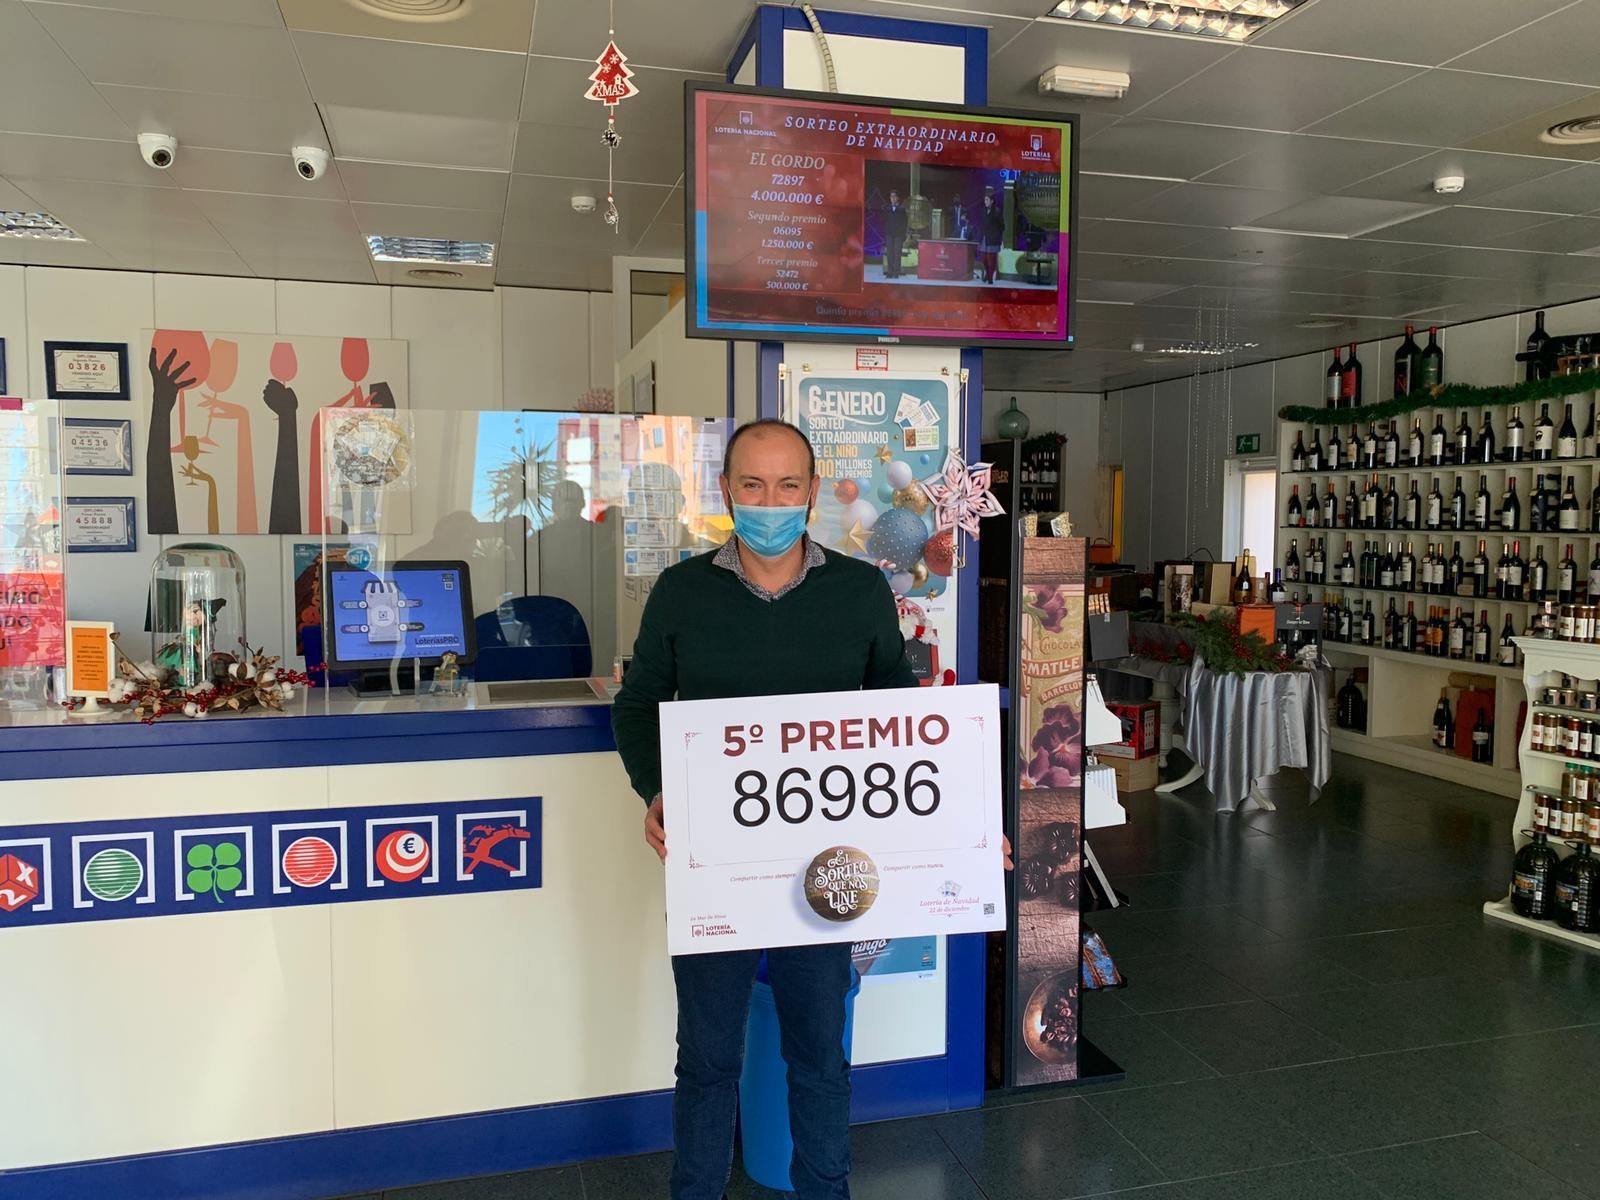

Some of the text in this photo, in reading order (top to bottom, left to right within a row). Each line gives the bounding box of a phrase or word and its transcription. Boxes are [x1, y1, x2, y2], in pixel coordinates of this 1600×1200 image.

[595, 82, 625, 97] XMAS
[743, 128, 777, 137] NACIONAL
[784, 116, 996, 144] SORTEO EXTRAORDINARIO
[846, 134, 944, 153] DE NAVIDAD
[749, 152, 825, 170] EL GORDO
[771, 174, 805, 186] 72897
[751, 190, 824, 205] 4.000.000 €
[747, 210, 827, 225] Segundo premio
[773, 226, 802, 236] 06095
[806, 241, 815, 250] €
[756, 255, 818, 268] Tercer premio
[766, 280, 801, 290] 500.000
[68, 362, 106, 371] 03826
[809, 385, 821, 413] 6
[825, 391, 886, 416] ENERO
[809, 416, 845, 430] SORTEO
[809, 431, 889, 444] EXTRAORDINARIO
[823, 444, 834, 458] EL
[836, 443, 858, 458] NIÑO
[815, 458, 873, 479] 00 MILLONES
[835, 470, 873, 479] EN PREMIOS
[723, 714, 950, 757] 5º PREMIO
[733, 760, 941, 828] 86986
[815, 861, 868, 888] SORTEO
[828, 875, 868, 893] QUE NOS
[823, 890, 859, 914] UNE
[952, 896, 980, 904] Navidad
